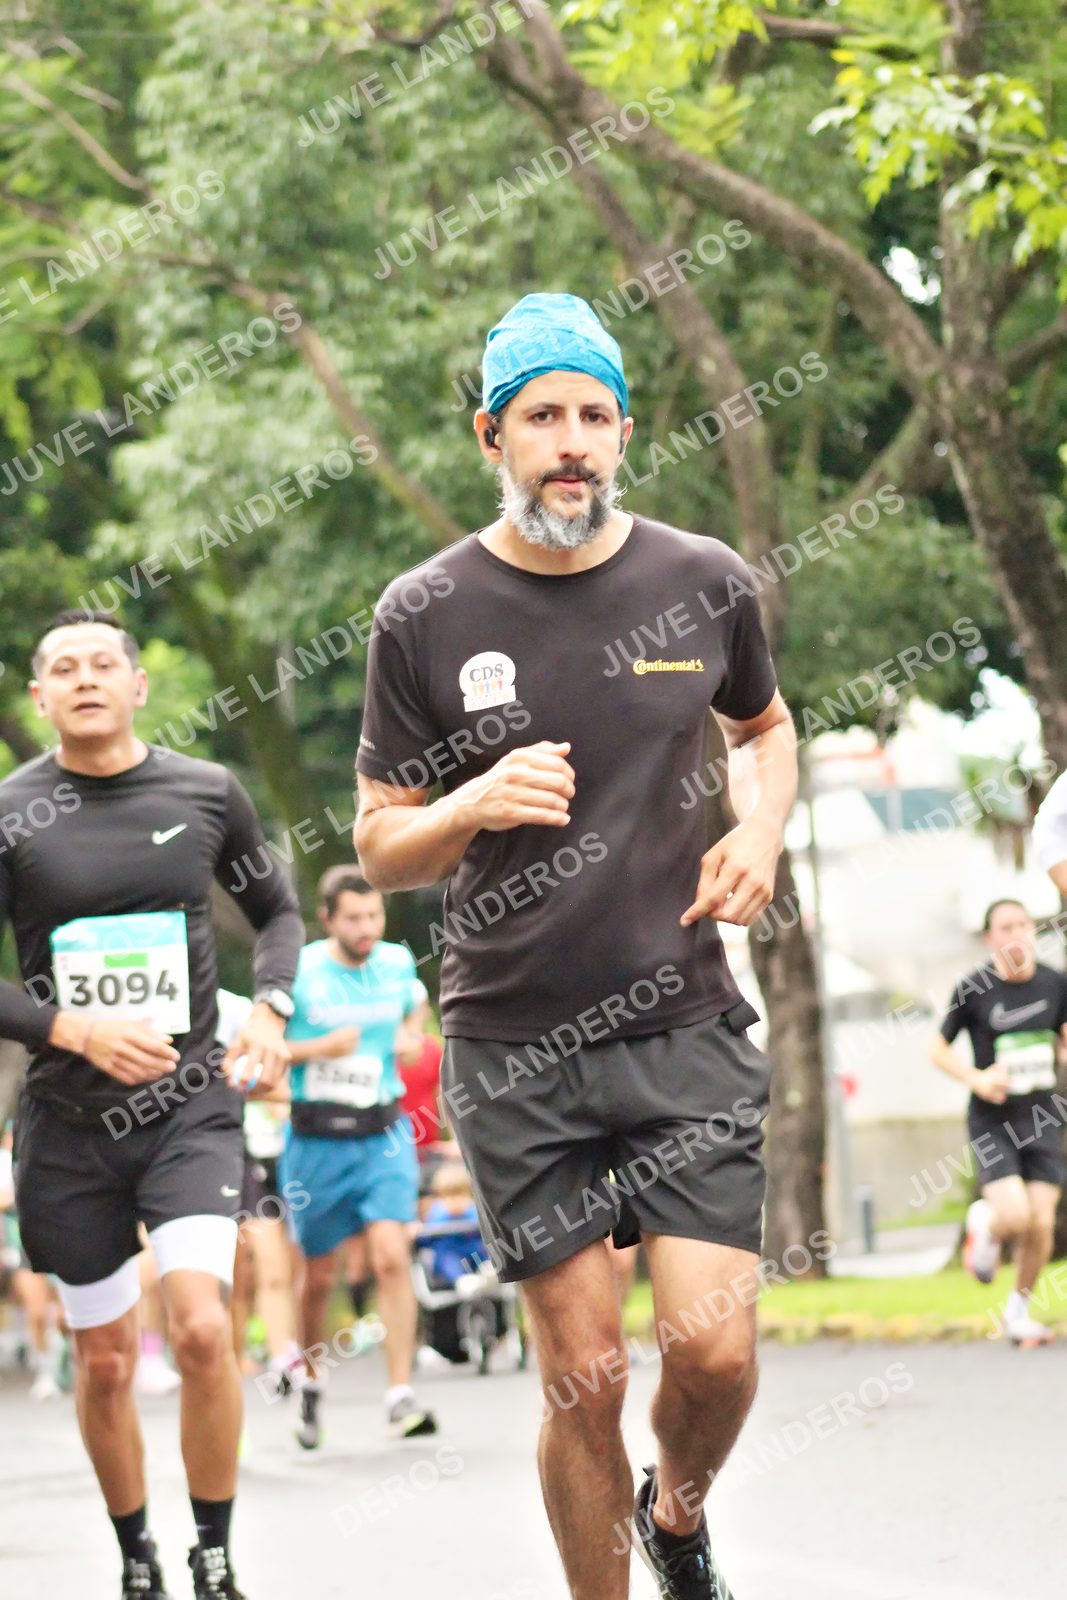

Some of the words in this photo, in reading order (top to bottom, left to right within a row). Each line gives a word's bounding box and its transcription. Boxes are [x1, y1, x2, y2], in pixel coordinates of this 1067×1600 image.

[469, 663, 504, 682] CDS
[633, 659, 695, 675] Continental
[69, 969, 178, 1007] 3094
